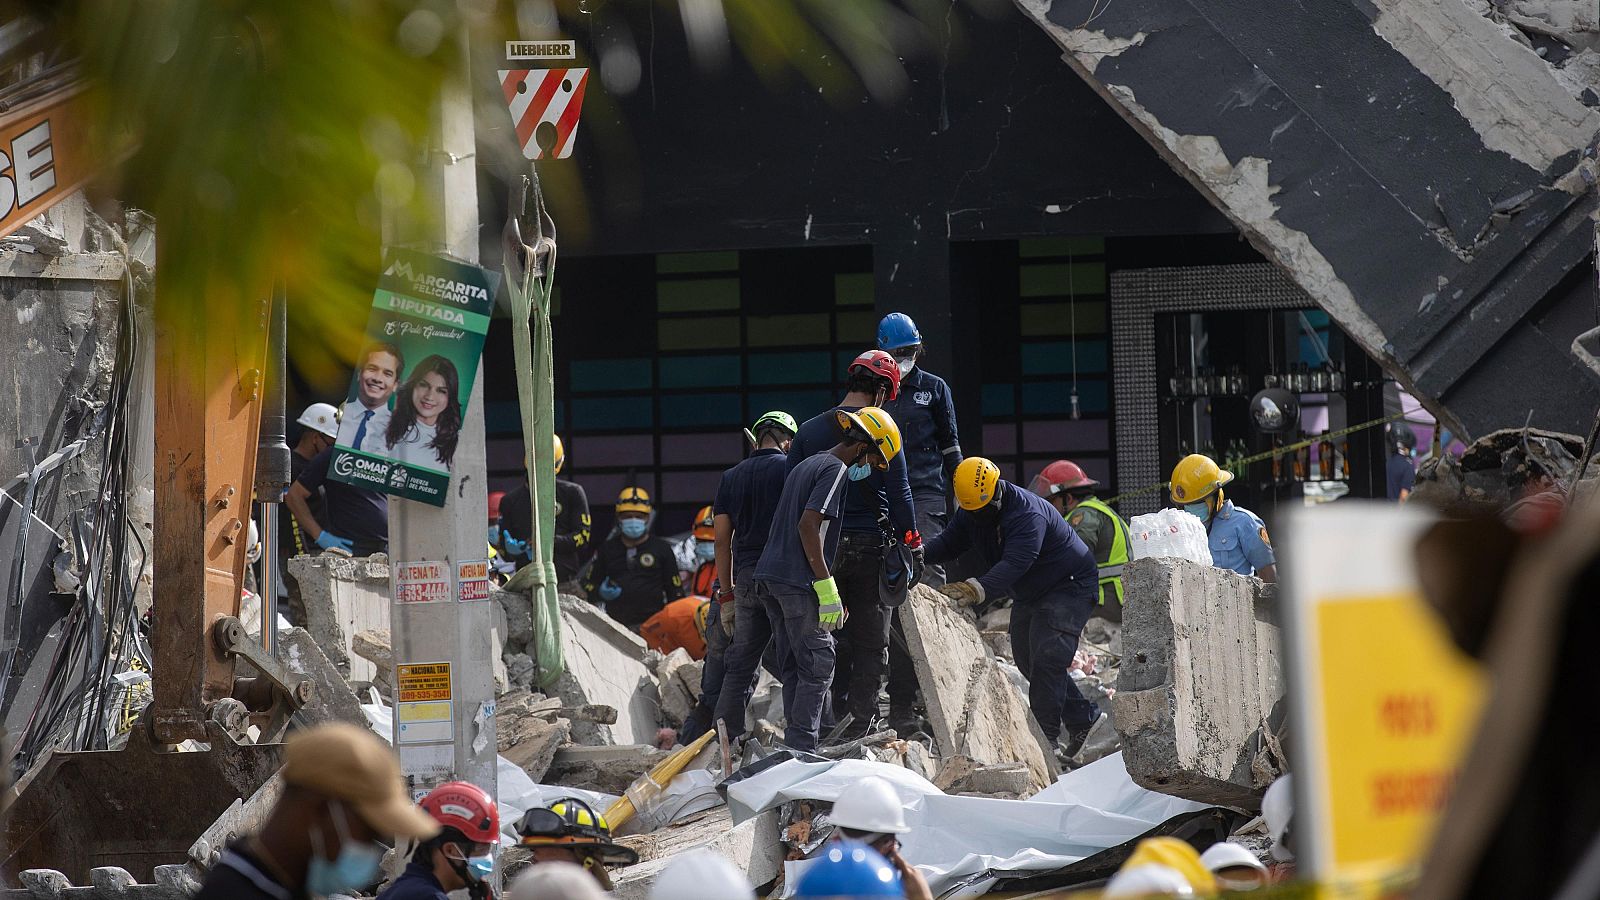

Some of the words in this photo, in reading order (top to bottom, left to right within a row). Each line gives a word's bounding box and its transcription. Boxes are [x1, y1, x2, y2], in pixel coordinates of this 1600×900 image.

[510, 44, 571, 56] LIEBHERR
[384, 259, 488, 301] MARGARITA
[413, 283, 470, 305] FELICIANO
[389, 295, 465, 326] DIPUTADA
[355, 459, 389, 476] OMAR
[352, 471, 385, 484] SENADOR
